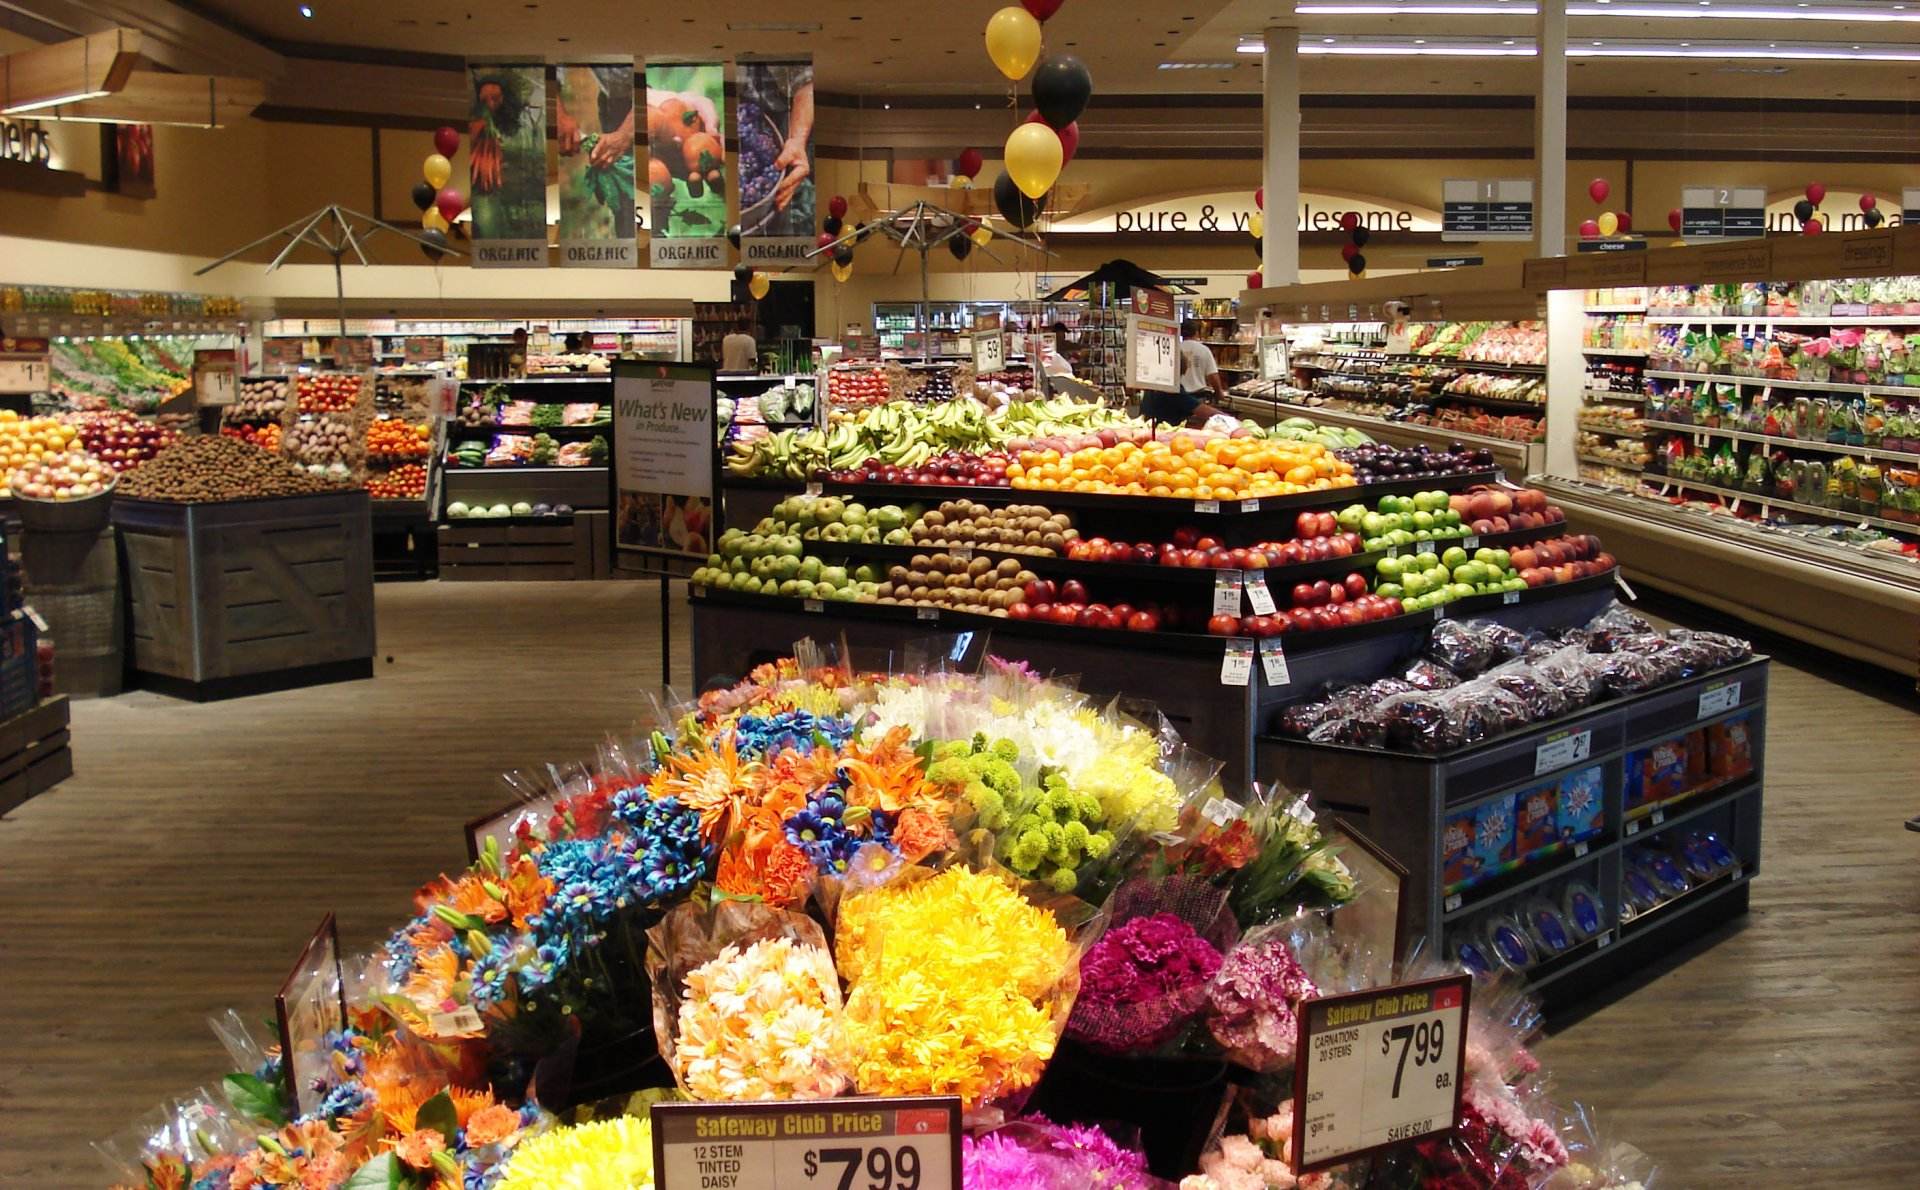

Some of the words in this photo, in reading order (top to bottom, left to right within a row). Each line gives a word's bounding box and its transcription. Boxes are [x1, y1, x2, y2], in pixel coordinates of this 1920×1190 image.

[1719, 189, 1729, 204] 2
[1116, 211, 1187, 232] pure
[1199, 204, 1219, 232] &
[1232, 203, 1412, 232] wlesome
[567, 245, 629, 261] ORGANIC
[658, 245, 719, 260] ORGANIC
[748, 244, 809, 259] ORGANIC
[1600, 242, 1625, 250] cheese
[478, 247, 540, 262] ORGANIC
[619, 399, 667, 420] What's
[671, 402, 708, 422] New
[1327, 1002, 1372, 1027] Safeway
[1375, 996, 1399, 1017] Club
[1401, 992, 1428, 1012] Price
[1314, 1029, 1359, 1049] CARNATIONS
[1328, 1044, 1352, 1060] STEMS
[1435, 1072, 1452, 1090] ea.
[695, 1115, 777, 1139] Safeway
[783, 1113, 827, 1136] Club
[832, 1112, 883, 1134] Price
[1387, 1125, 1411, 1142] SAVE
[1411, 1118, 1433, 1136] $2.00
[693, 1146, 706, 1160] 12
[709, 1145, 743, 1159] STEM
[697, 1160, 740, 1174] TINTED
[701, 1175, 738, 1189] DAISY
